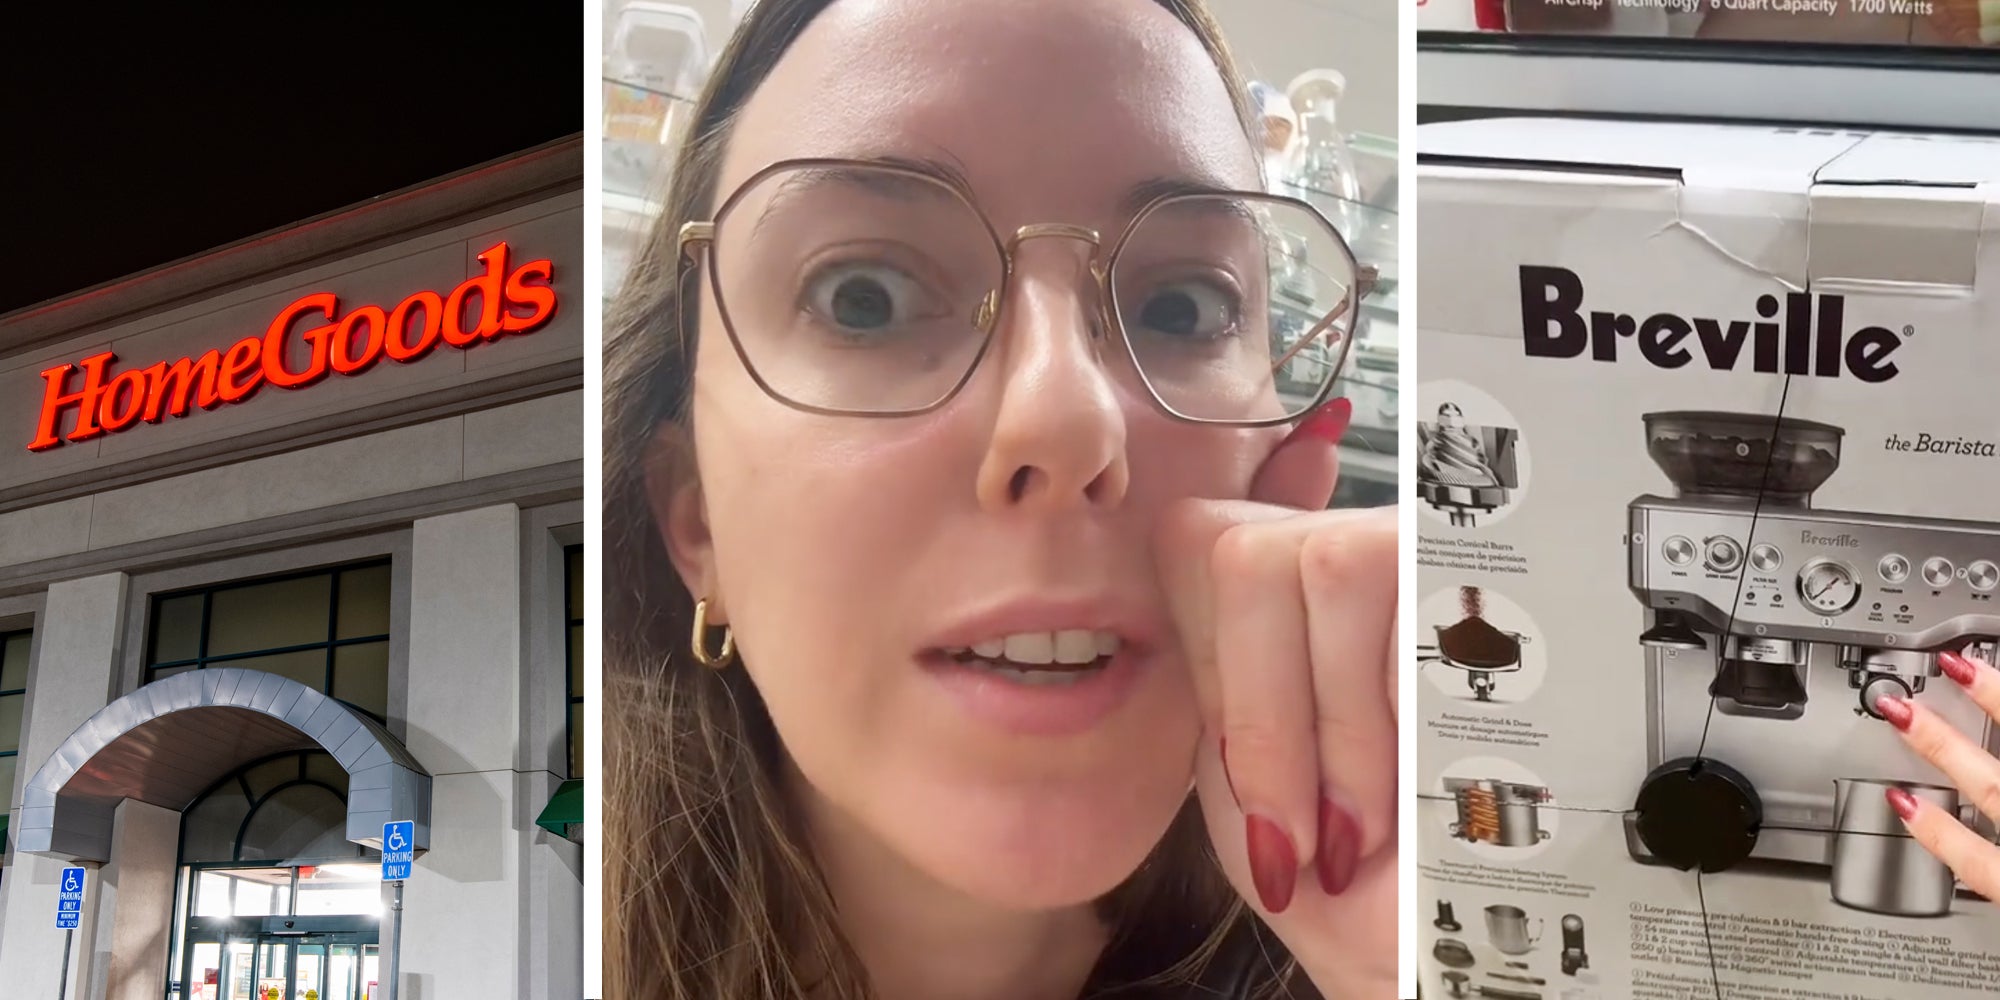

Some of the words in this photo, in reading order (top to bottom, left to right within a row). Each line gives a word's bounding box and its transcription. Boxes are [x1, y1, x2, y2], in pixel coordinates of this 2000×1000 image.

[1724, 0, 1768, 10] Quart
[1771, 0, 1838, 16] Capacity
[1849, 0, 1885, 13] 1700
[1890, 0, 1933, 15] Watts
[26, 241, 559, 453] HomeGoods
[1885, 433, 1911, 451] the
[1913, 433, 1995, 456] Barista
[1418, 536, 1456, 546] Precision
[1457, 538, 1489, 549] Conical
[1490, 542, 1514, 551] Burrs
[1800, 530, 1860, 548] Breville
[1476, 552, 1487, 560] de
[1478, 563, 1488, 571] de
[1482, 716, 1504, 726] Grind
[383, 851, 412, 864] PARKING
[388, 864, 406, 877] ONLY
[60, 891, 81, 901] PARKING
[63, 901, 77, 911] ONLY
[1644, 904, 1664, 913] Low
[1711, 912, 1771, 926] pre-infusion
[1773, 918, 1780, 926] &
[1791, 919, 1807, 929] bar
[1810, 924, 1861, 935] extraction
[1878, 929, 1930, 944] Electronic
[1931, 936, 1951, 946] PID
[1630, 913, 1689, 926] temperature
[1743, 925, 1794, 938] Automatic
[1851, 936, 1884, 950] dosing
[1902, 943, 1955, 957] Adjustable
[1957, 951, 1986, 960] grind
[1645, 924, 1657, 933] 54
[1680, 928, 1722, 940] stainess
[1749, 936, 1799, 949] portafilter
[1842, 947, 1860, 957] cup
[1862, 949, 1892, 960] single
[1903, 954, 1926, 963] dual
[1928, 957, 1949, 966] wall
[1951, 958, 1975, 969] filter
[1675, 956, 1728, 969] Removble
[1690, 939, 1742, 952] voletric
[1796, 951, 1849, 964] Adjustable
[1851, 958, 1914, 972] temperature
[1931, 966, 1987, 980] Removable
[1709, 978, 1737, 989] bsse
